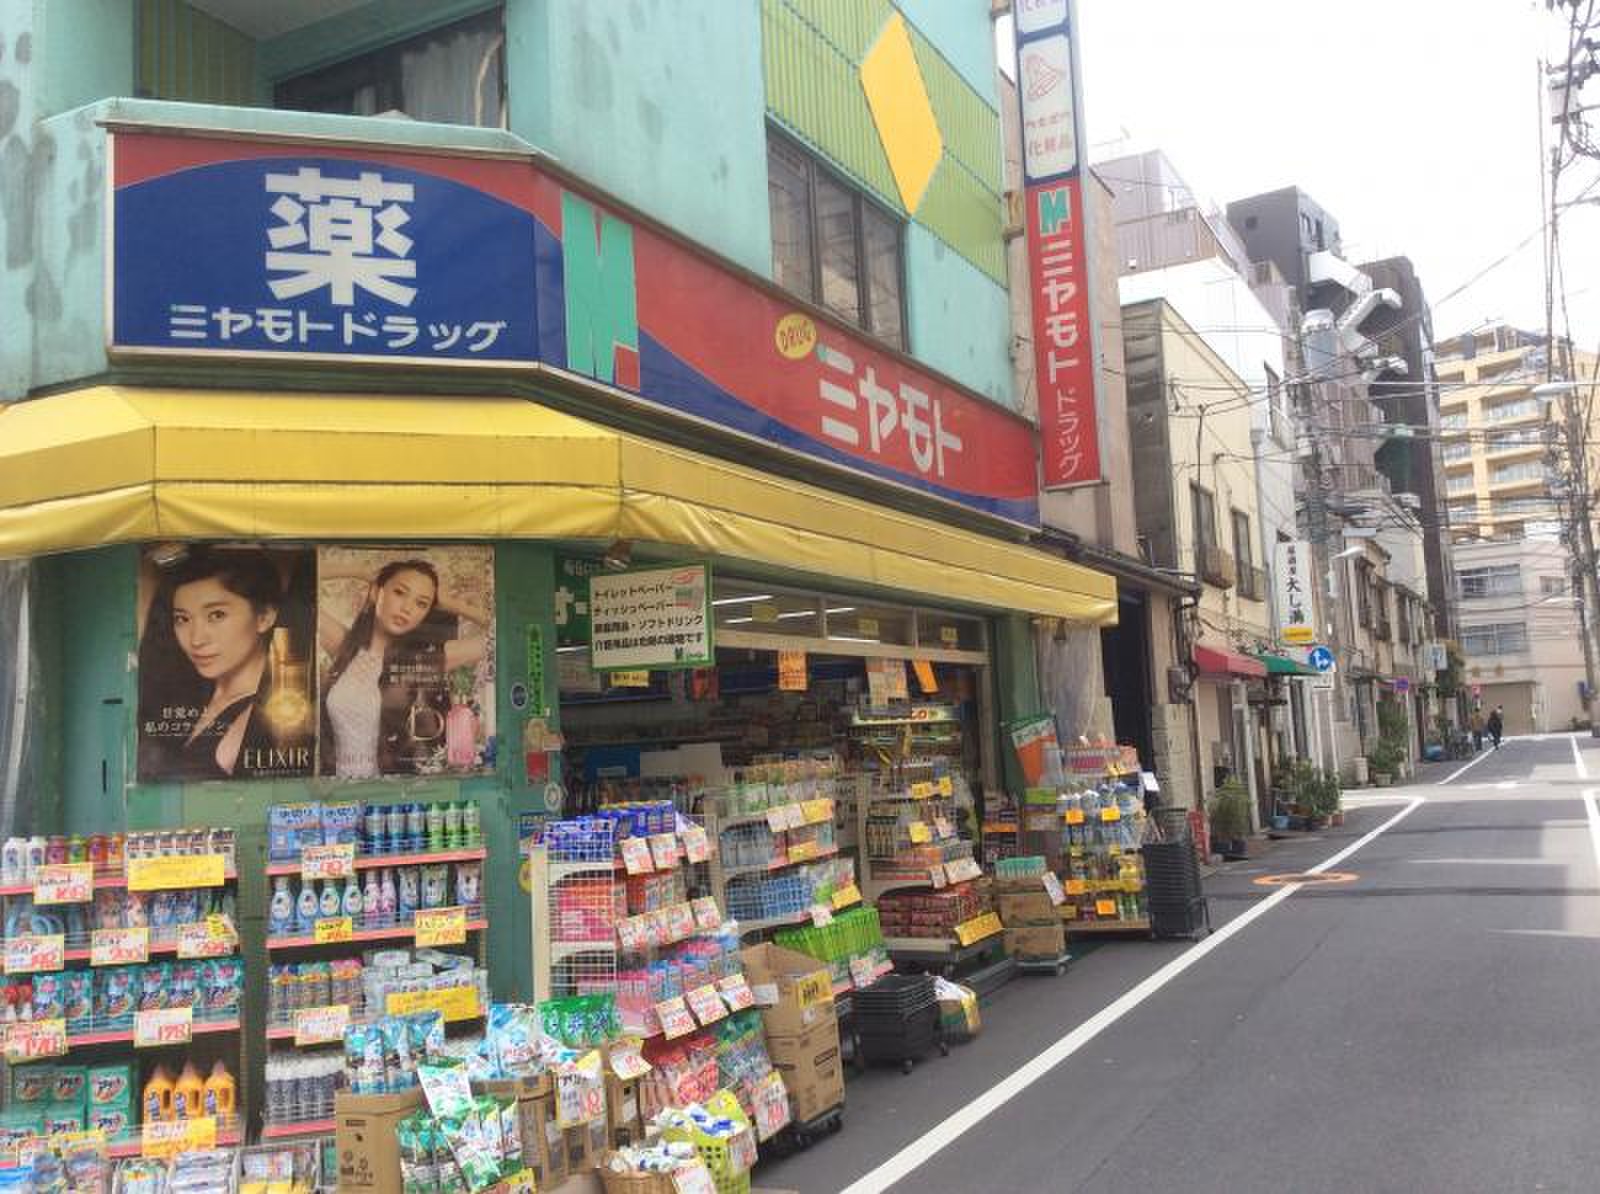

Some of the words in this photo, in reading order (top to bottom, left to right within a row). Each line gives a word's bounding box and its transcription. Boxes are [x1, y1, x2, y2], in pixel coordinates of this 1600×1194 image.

[265, 167, 417, 306] 薬
[170, 303, 507, 352] ミヤモトドラッグ
[1041, 240, 1080, 384] ミヤモト
[815, 344, 963, 478] ミヤモト
[1057, 388, 1083, 479] ドラッグ
[243, 747, 310, 769] ELIXIR
